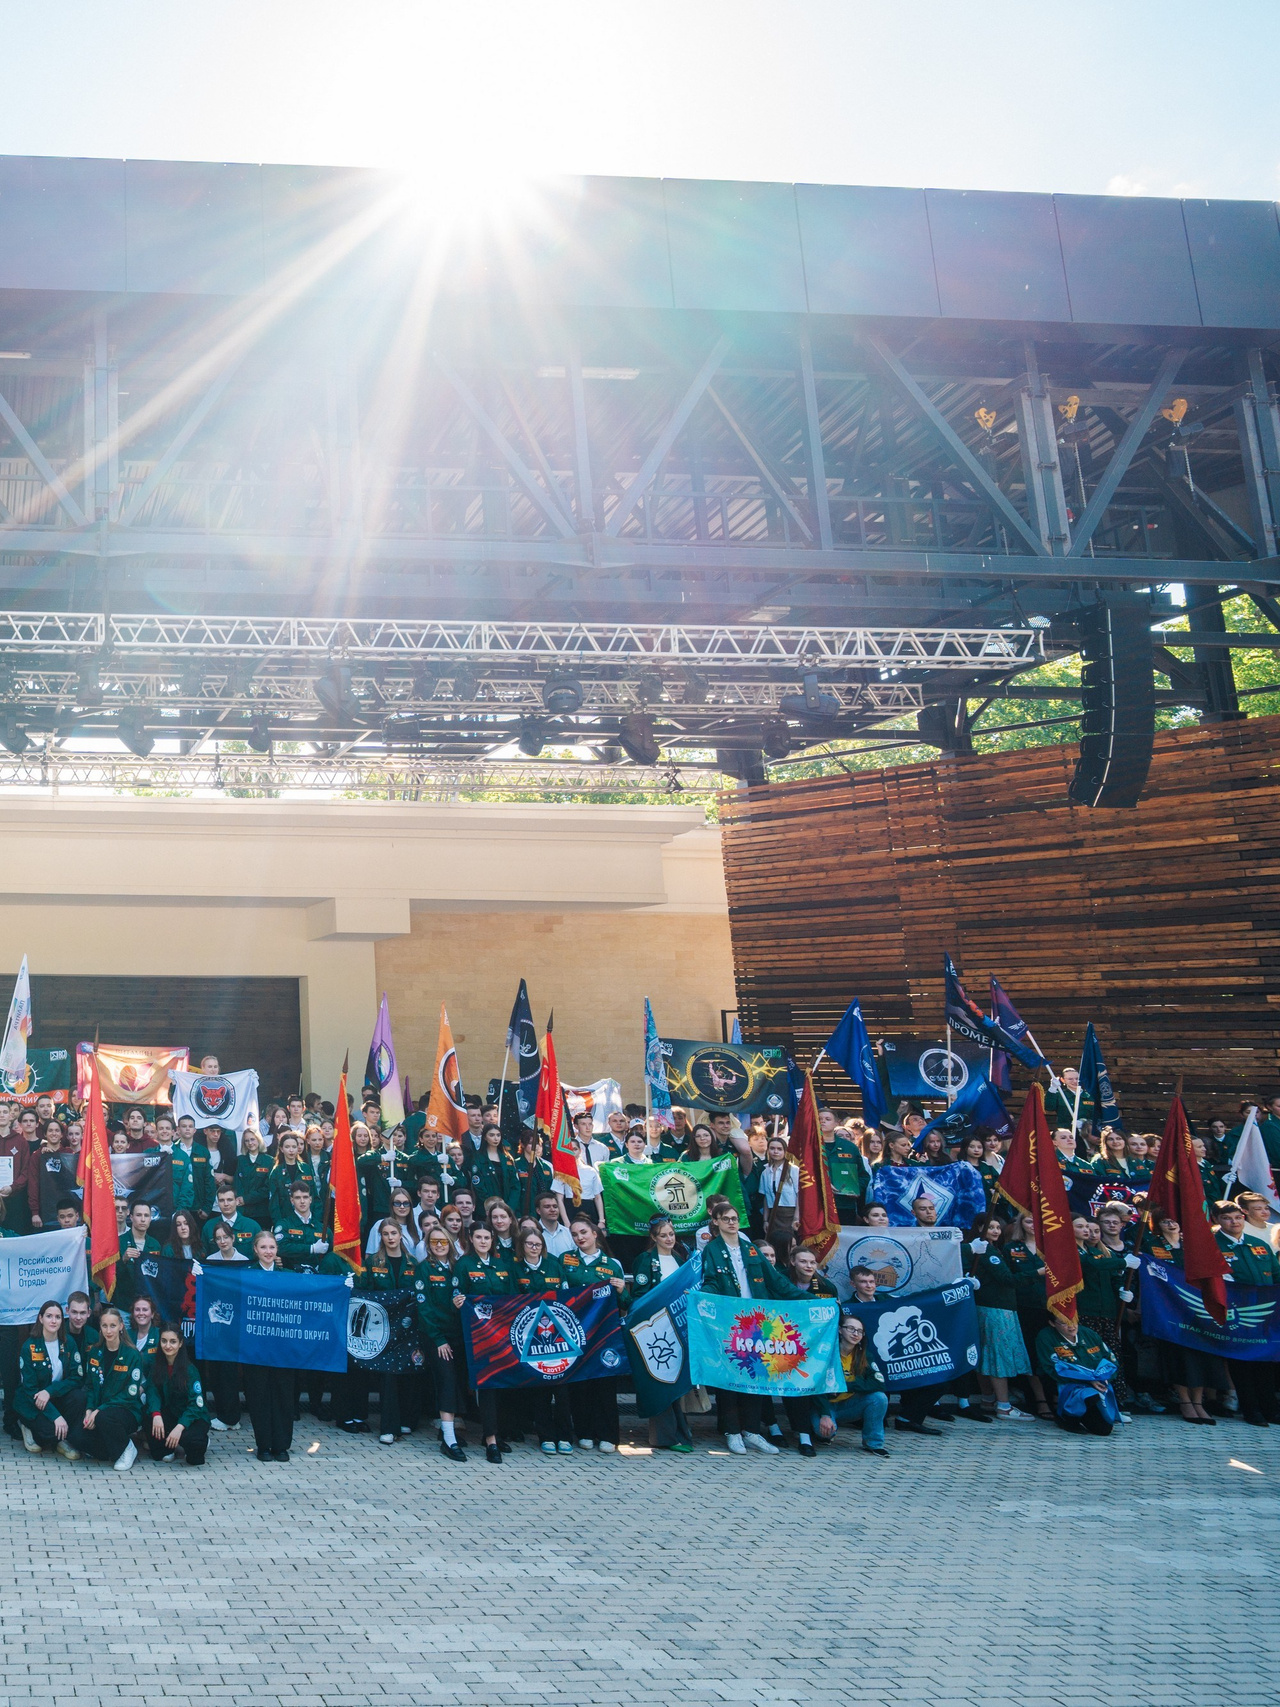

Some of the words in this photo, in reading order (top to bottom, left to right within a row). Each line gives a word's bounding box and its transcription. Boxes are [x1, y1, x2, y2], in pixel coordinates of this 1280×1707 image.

[115, 1048, 153, 1057] ВИТАМИН
[650, 1168, 681, 1195] СТУДЕНЧЕСКИЕ
[940, 1230, 952, 1240] ВСО
[18, 1255, 64, 1267] Российские
[18, 1265, 72, 1279] Студенческие
[18, 1278, 48, 1289] Отряды
[956, 1284, 970, 1300] ВСО
[221, 1302, 234, 1310] РСО
[247, 1295, 303, 1311] СТУДЕНЧЕСКИЕ
[304, 1300, 334, 1314] ОТРЯДЫ
[246, 1309, 302, 1325] ЦЕНТРАЛЬНОГО
[246, 1324, 303, 1340] ФЕДЕРАЛЬНОГО
[304, 1329, 330, 1341] ОКРУГА
[511, 1305, 531, 1345] СТУДЕНЧЕСКИЙ
[577, 1324, 587, 1346] ОТРЯД
[1178, 1322, 1201, 1333] ШТАБ
[1204, 1330, 1232, 1341] ЛИДЕР
[531, 1342, 570, 1356] ДЕЛЬТА
[736, 1336, 798, 1356] КРАСКИ
[546, 1366, 562, 1374] 2017
[887, 1352, 952, 1375] ЛОКОМОТИВ
